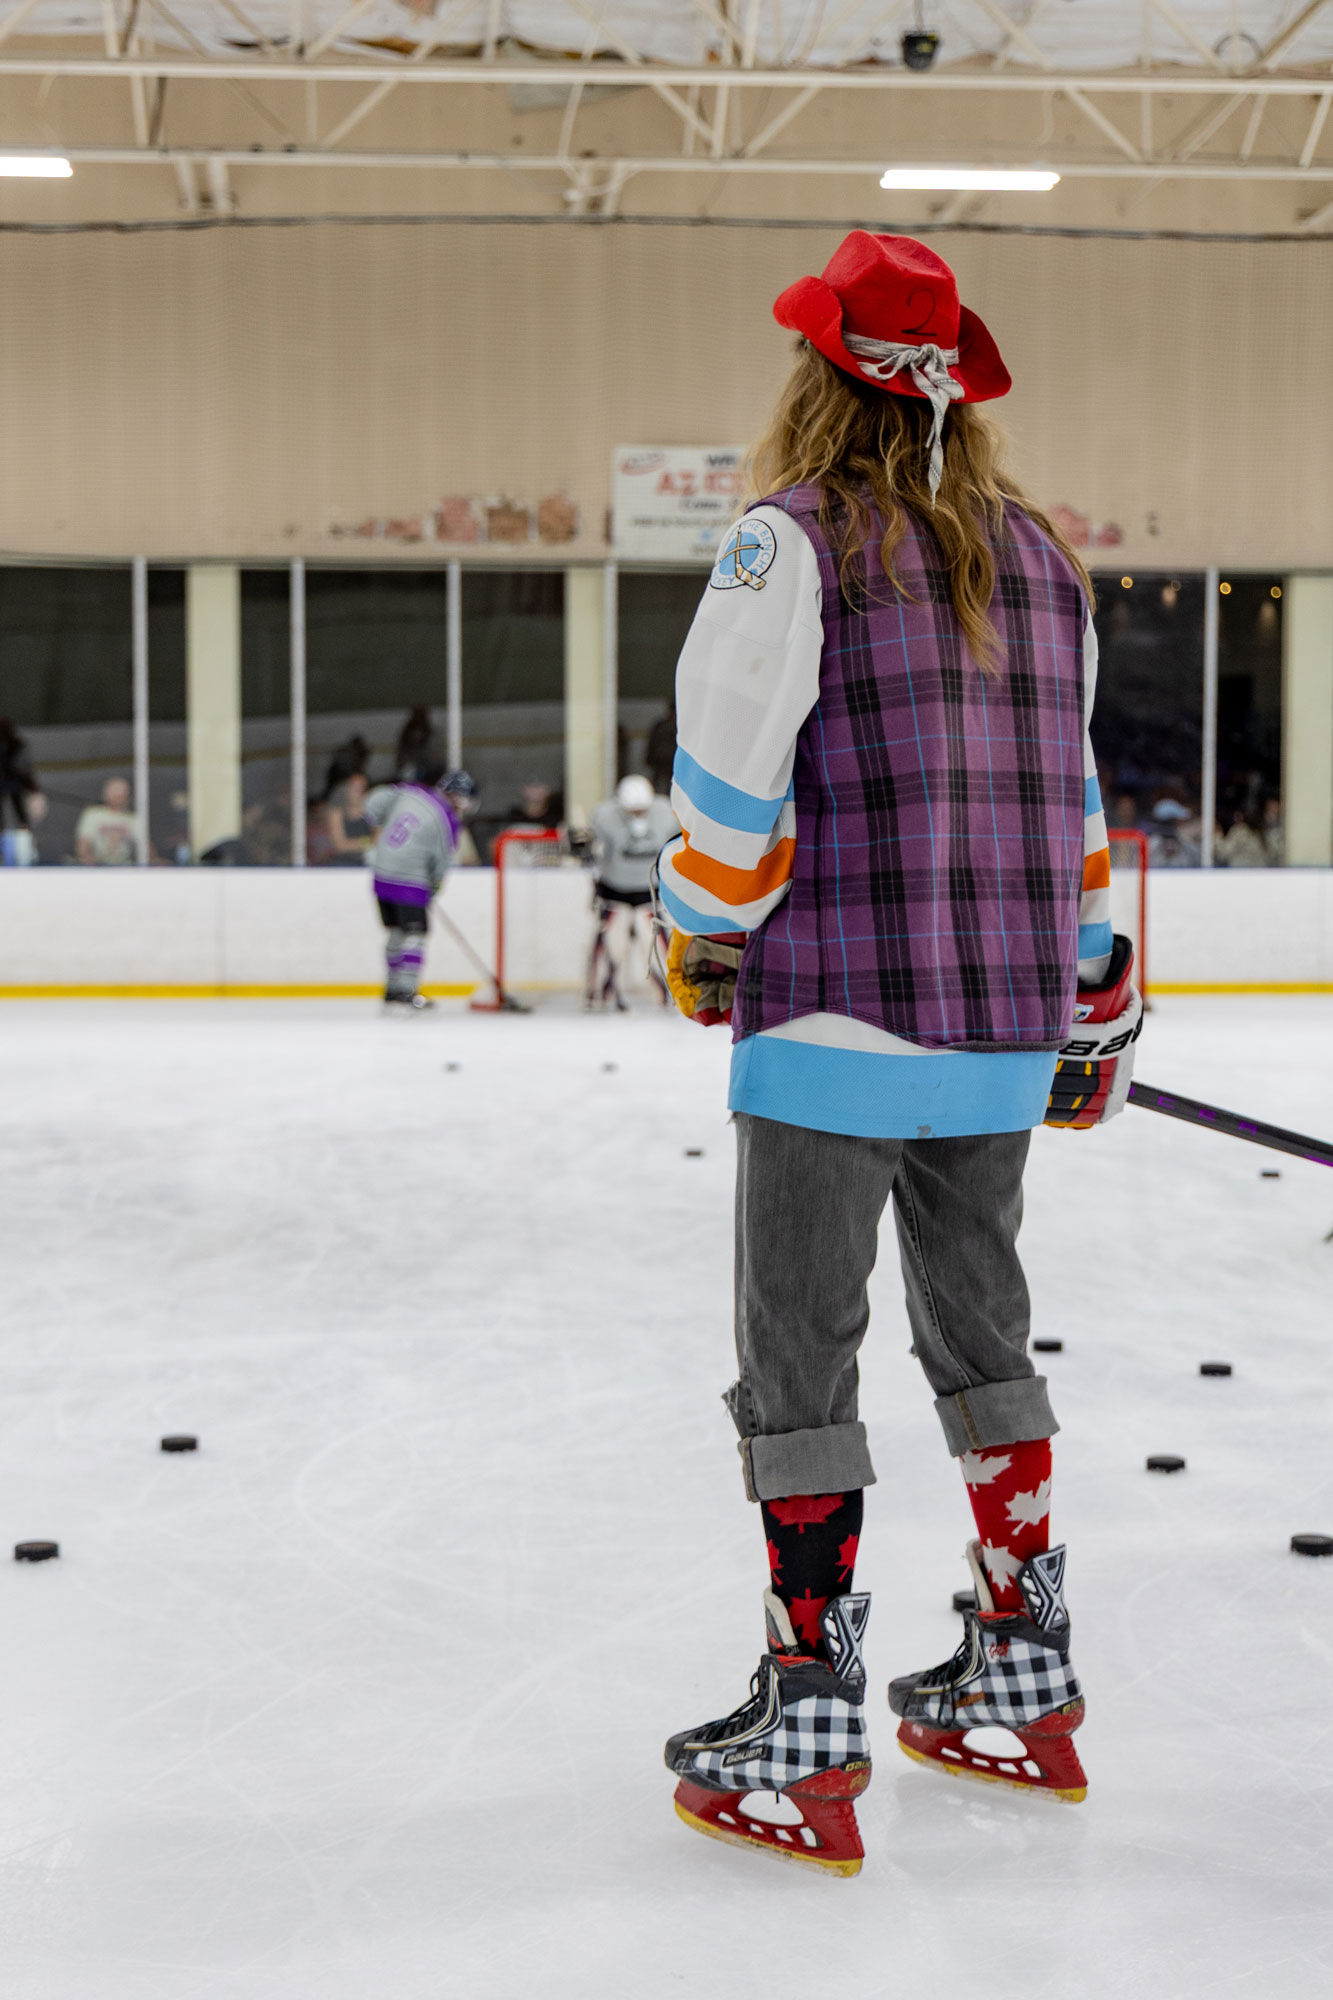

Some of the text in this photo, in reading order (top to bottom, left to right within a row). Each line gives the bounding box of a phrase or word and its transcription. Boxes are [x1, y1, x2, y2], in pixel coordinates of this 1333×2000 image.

[902, 287, 937, 337] 2
[756, 529, 773, 570] BENCH
[725, 1746, 764, 1765] BAUER
